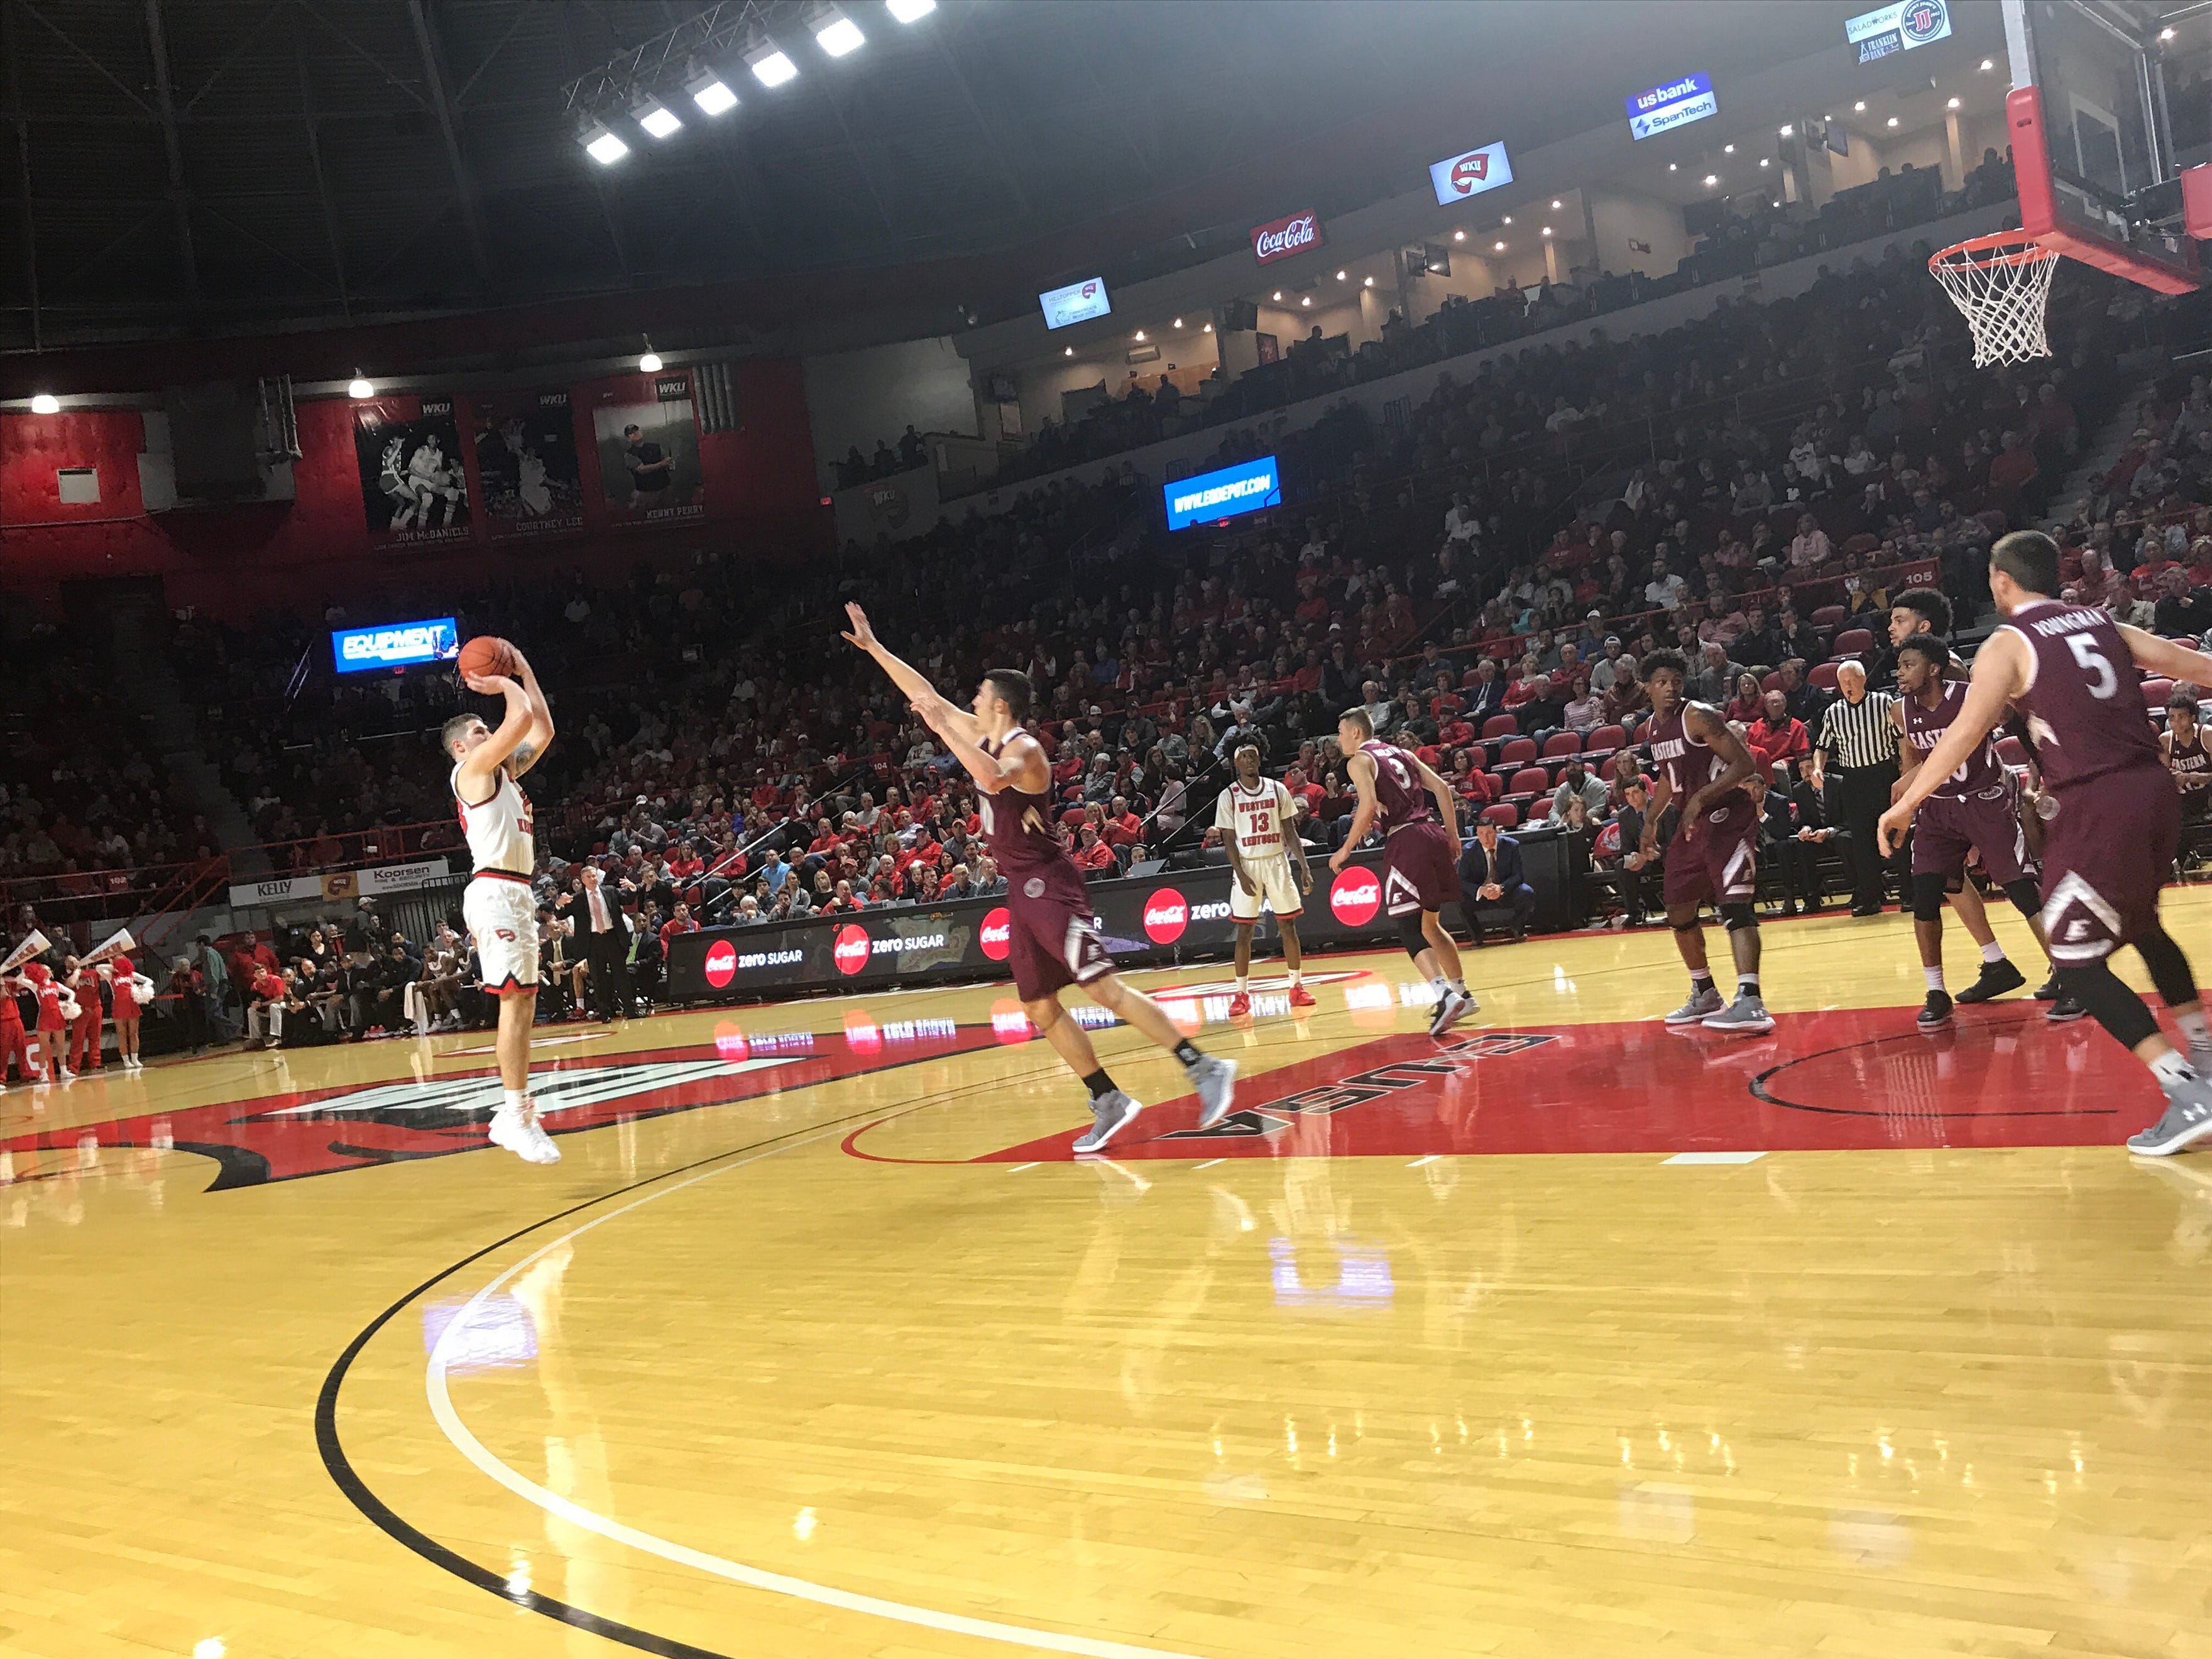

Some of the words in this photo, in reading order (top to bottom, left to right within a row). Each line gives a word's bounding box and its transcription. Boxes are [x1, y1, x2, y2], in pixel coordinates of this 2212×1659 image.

[1867, 32, 1898, 51] FRANKLIN
[1652, 101, 1712, 127] SpanTech
[1459, 160, 1481, 173] WKU
[1257, 216, 1315, 258] Coca-Cola
[659, 382, 686, 394] WKU
[539, 394, 567, 405] WKU
[422, 403, 450, 414] WKU
[516, 519, 562, 532] COURTNEY
[396, 533, 415, 542] JIM
[1906, 571, 1933, 584] 105
[2063, 632, 2117, 699] 5
[1909, 728, 1947, 749] EAST
[1388, 758, 1411, 789] 3
[1238, 798, 1275, 813] WESTERN
[1250, 812, 1269, 833] 13
[1241, 833, 1281, 847] KENTUCKY
[374, 867, 430, 879] Koorsen
[257, 881, 292, 897] KELLY
[1333, 885, 1379, 906] Coca-Cola
[1393, 892, 1403, 903] E
[1145, 906, 1185, 926] Coca-Cola
[1191, 901, 1230, 921] zero
[872, 938, 902, 954] zero
[905, 934, 944, 950] SUGAR
[738, 953, 765, 968] zero
[767, 950, 802, 965] SUGAR
